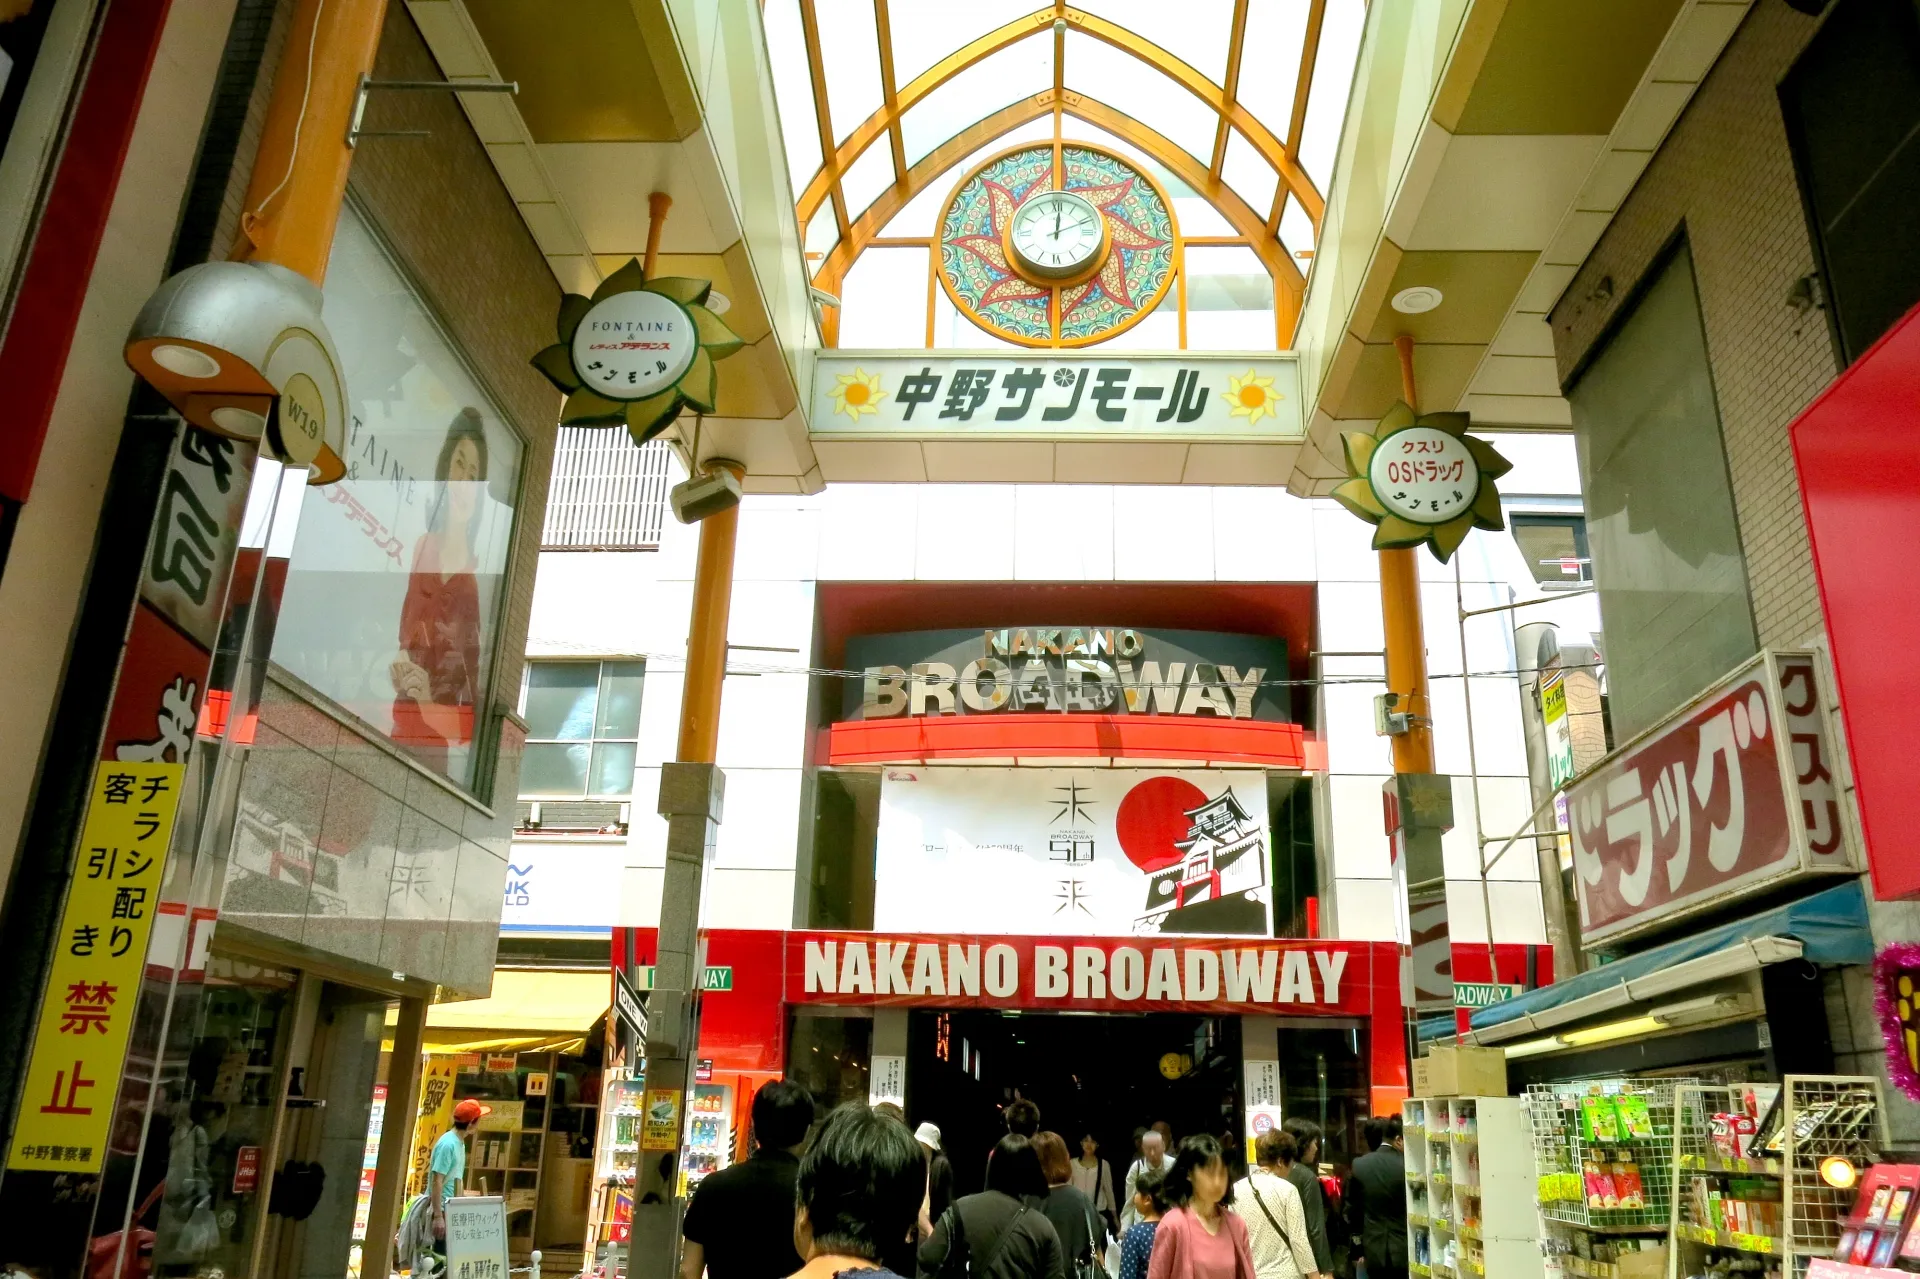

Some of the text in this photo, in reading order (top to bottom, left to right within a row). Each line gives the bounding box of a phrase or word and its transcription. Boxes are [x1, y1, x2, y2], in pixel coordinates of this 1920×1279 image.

[592, 321, 673, 332] FONTAINE
[587, 360, 668, 383] サンモール
[895, 367, 1210, 423] 中野サンモール
[288, 395, 318, 440] W19
[1402, 440, 1444, 453] クスリ
[1388, 460, 1464, 484] OSドラッグ
[1393, 490, 1463, 512] サンモール
[983, 629, 1144, 658] NAKANO
[863, 658, 1267, 718] BROADWAY
[1780, 665, 1841, 854] クスリ
[1569, 690, 1767, 927] ドラッグ
[70, 772, 137, 957] 客引き
[111, 774, 170, 958] チラシ配り
[804, 940, 1349, 1004] NAKANO BROADWAY
[620, 990, 638, 1020] ONE
[1454, 986, 1508, 1005] ADWAY
[40, 979, 118, 1116] 禁止
[21, 1144, 93, 1163] 中野警察署
